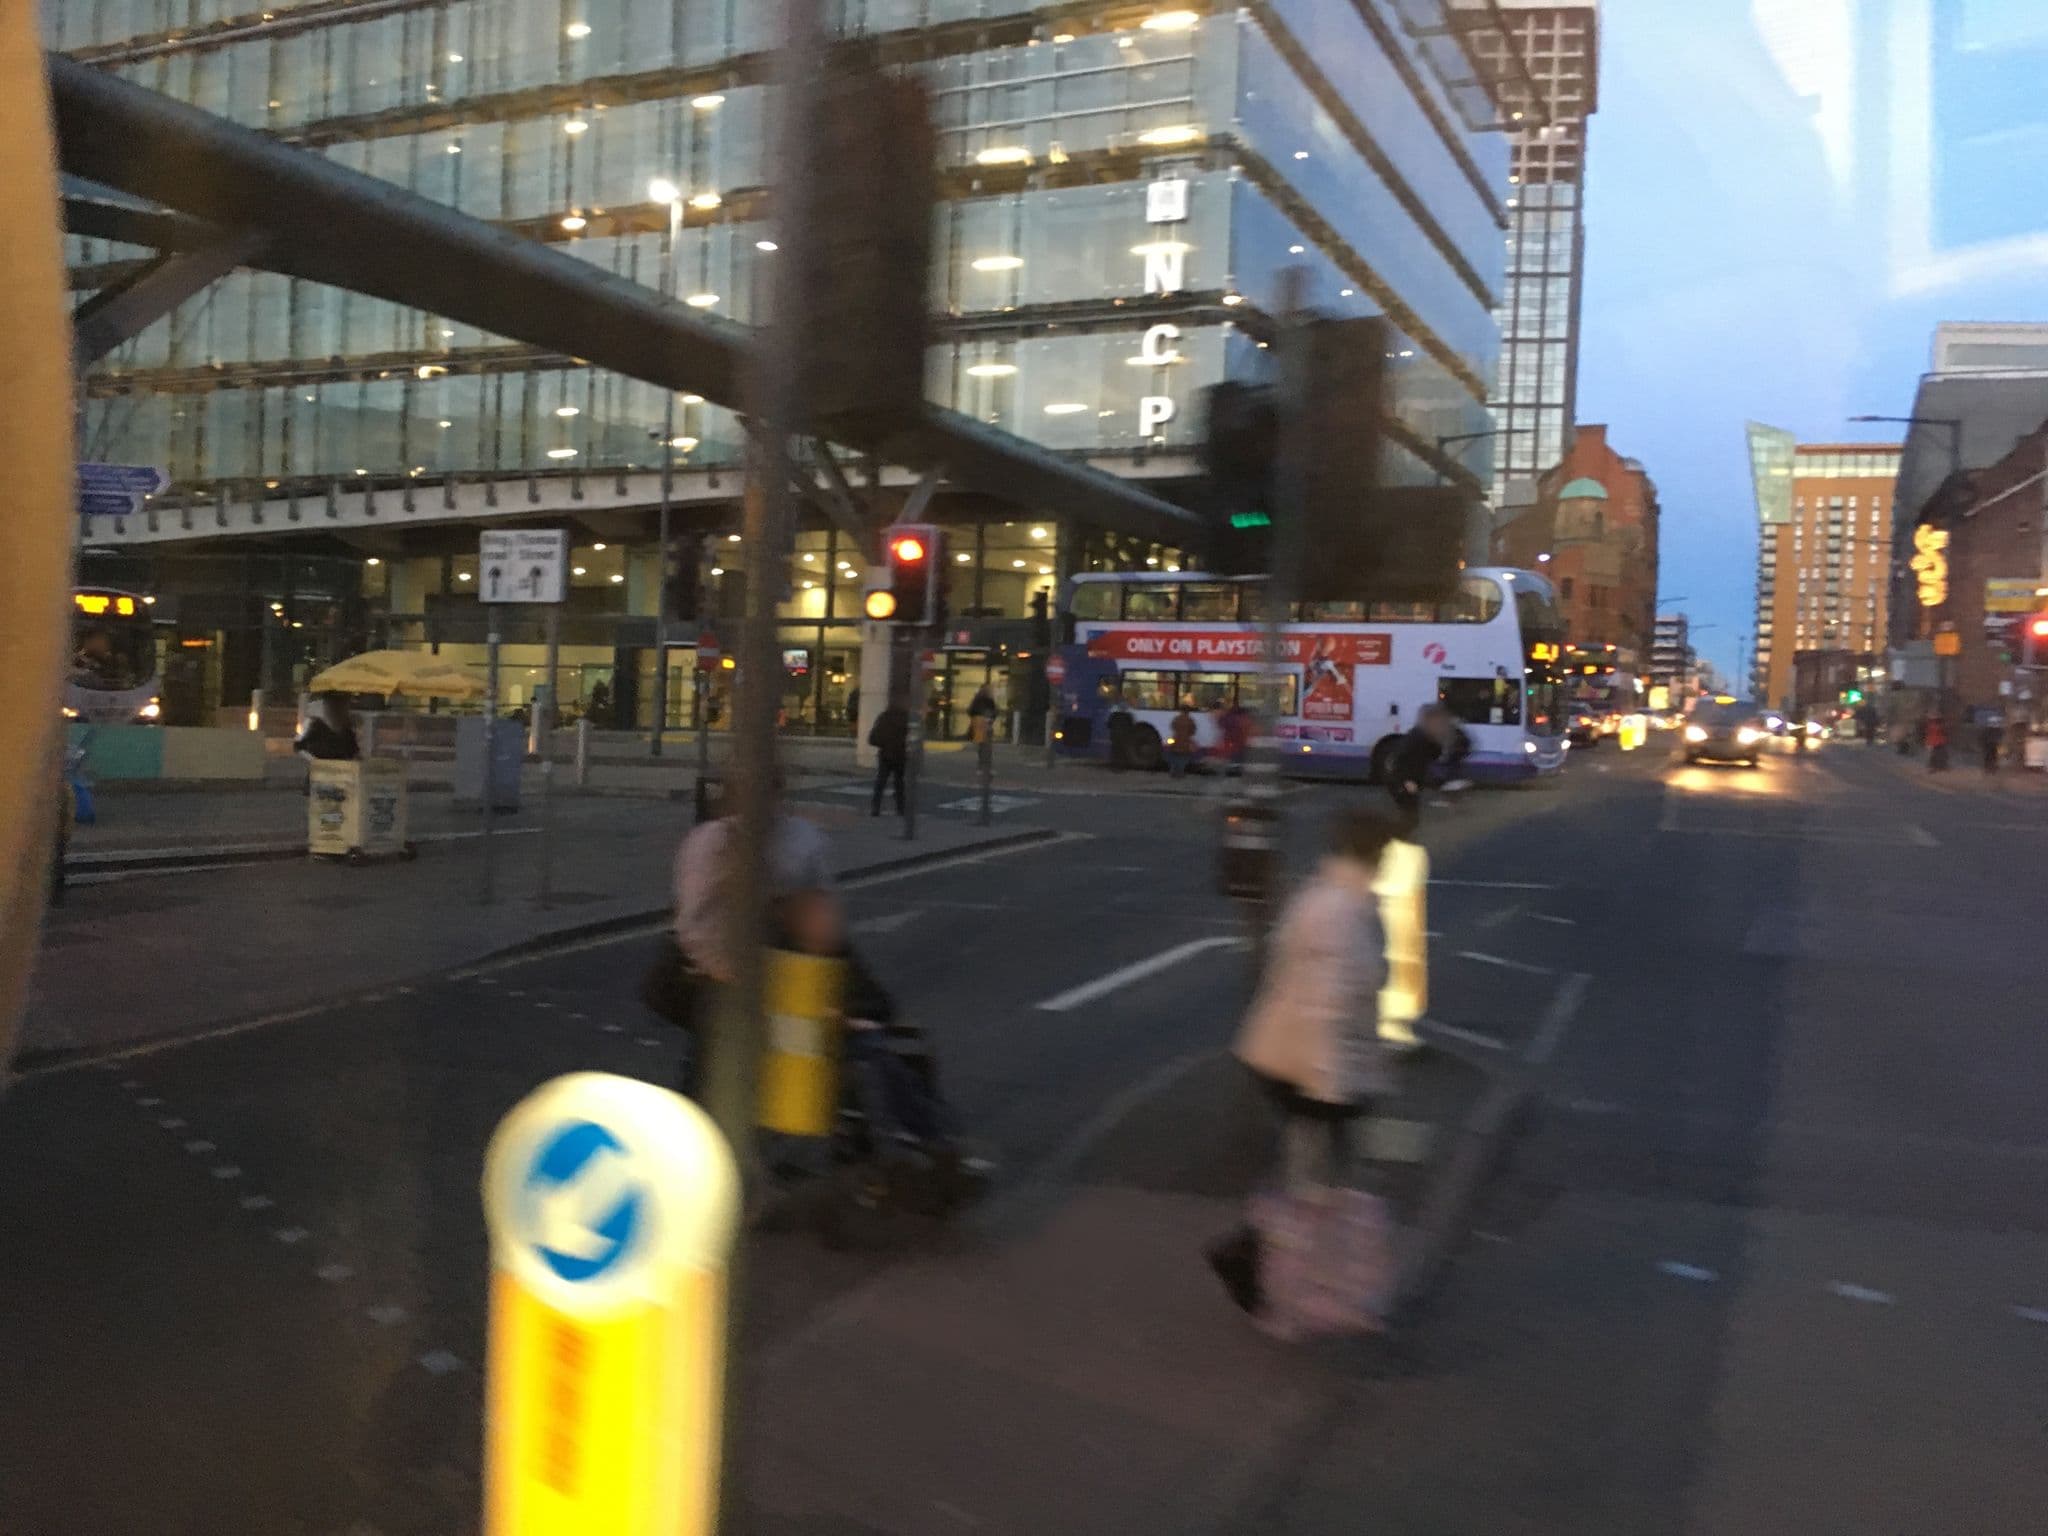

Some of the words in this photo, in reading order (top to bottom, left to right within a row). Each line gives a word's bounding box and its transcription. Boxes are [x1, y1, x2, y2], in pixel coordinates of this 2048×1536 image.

[1139, 249, 1184, 437] NCP
[1127, 637, 1166, 653] ONLY
[1169, 638, 1192, 654] ON
